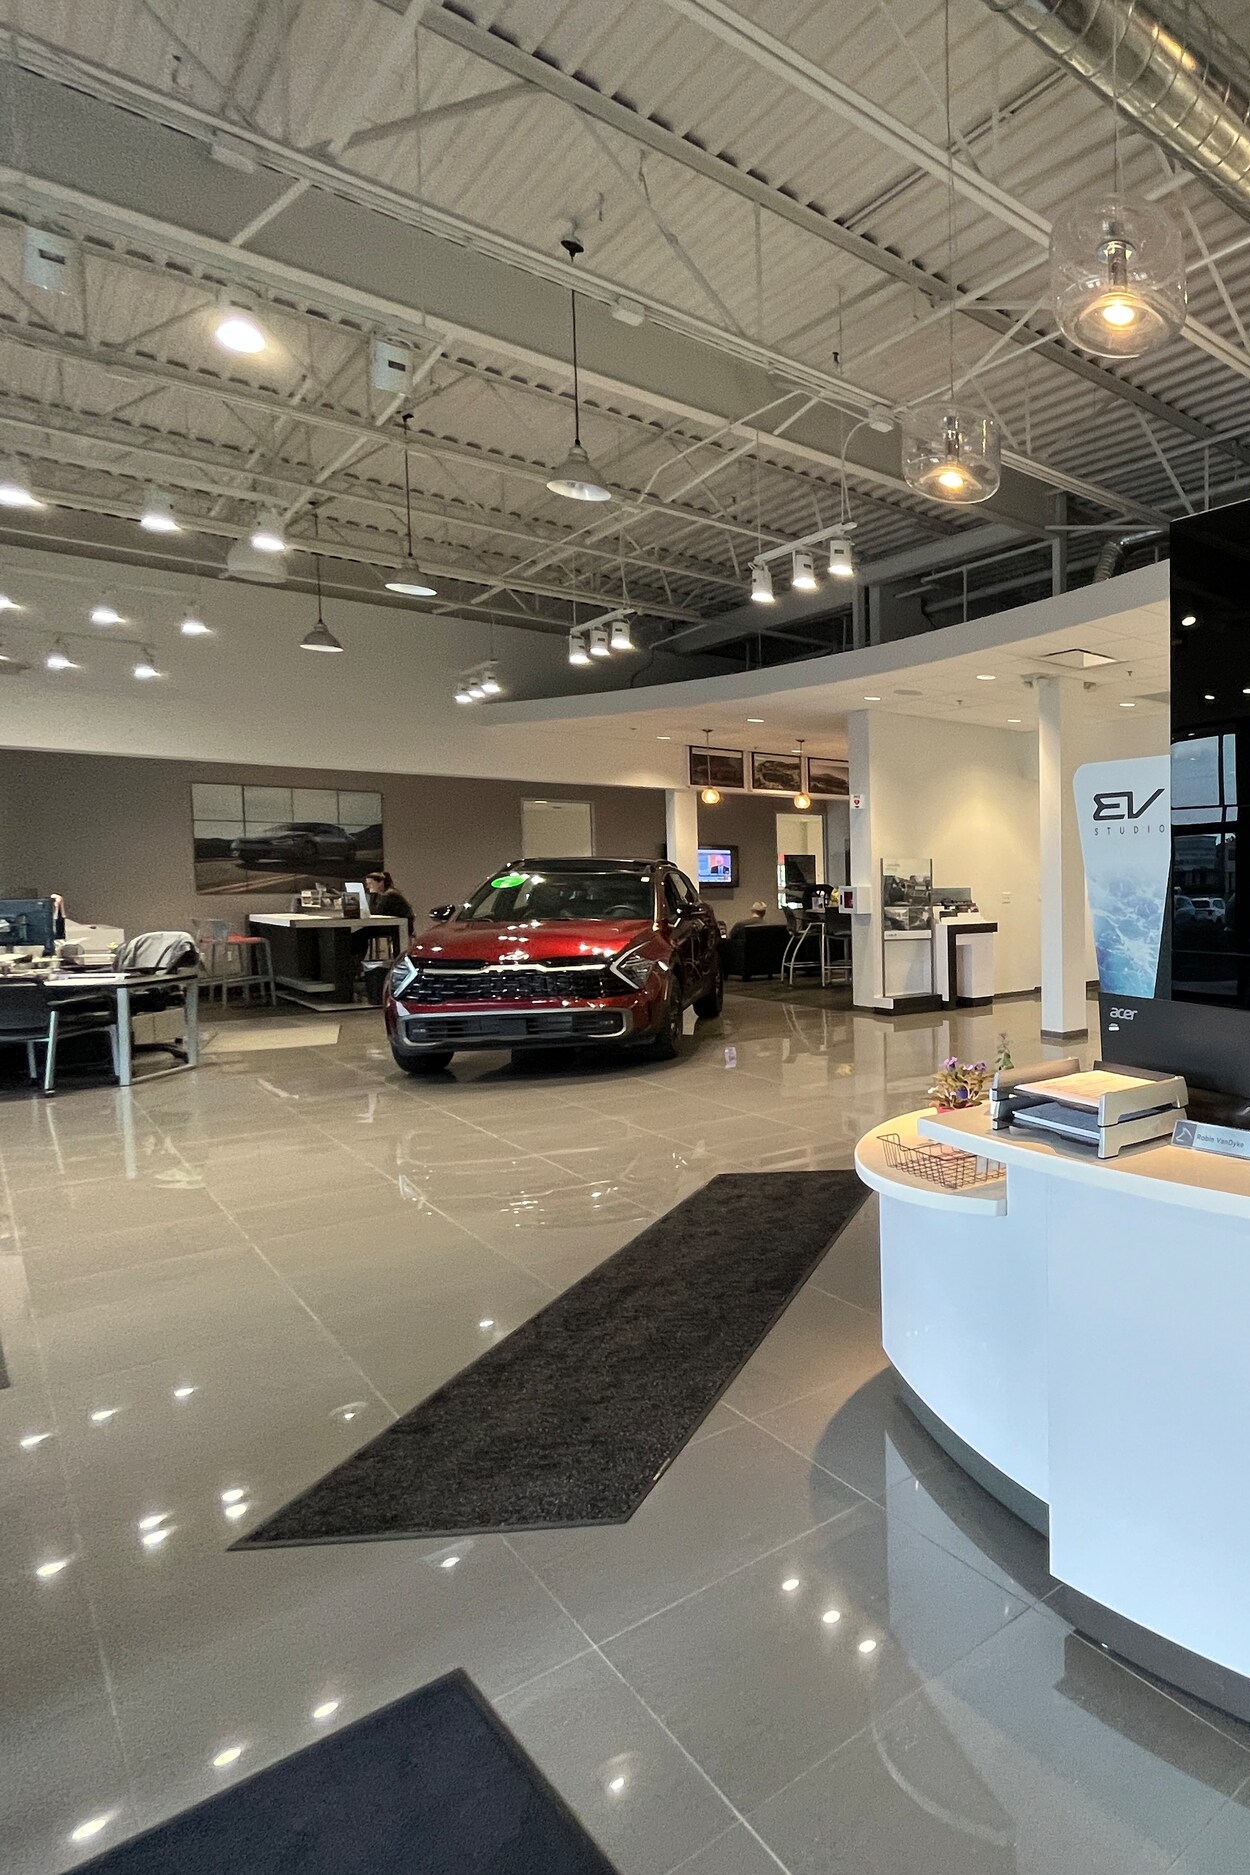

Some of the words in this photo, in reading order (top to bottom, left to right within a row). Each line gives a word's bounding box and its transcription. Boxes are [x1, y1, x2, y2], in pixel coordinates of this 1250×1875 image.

[1093, 788, 1165, 821] EV
[1094, 824, 1165, 836] STUDIO
[1109, 1007, 1138, 1020] acer
[1197, 1133, 1215, 1143] Robin
